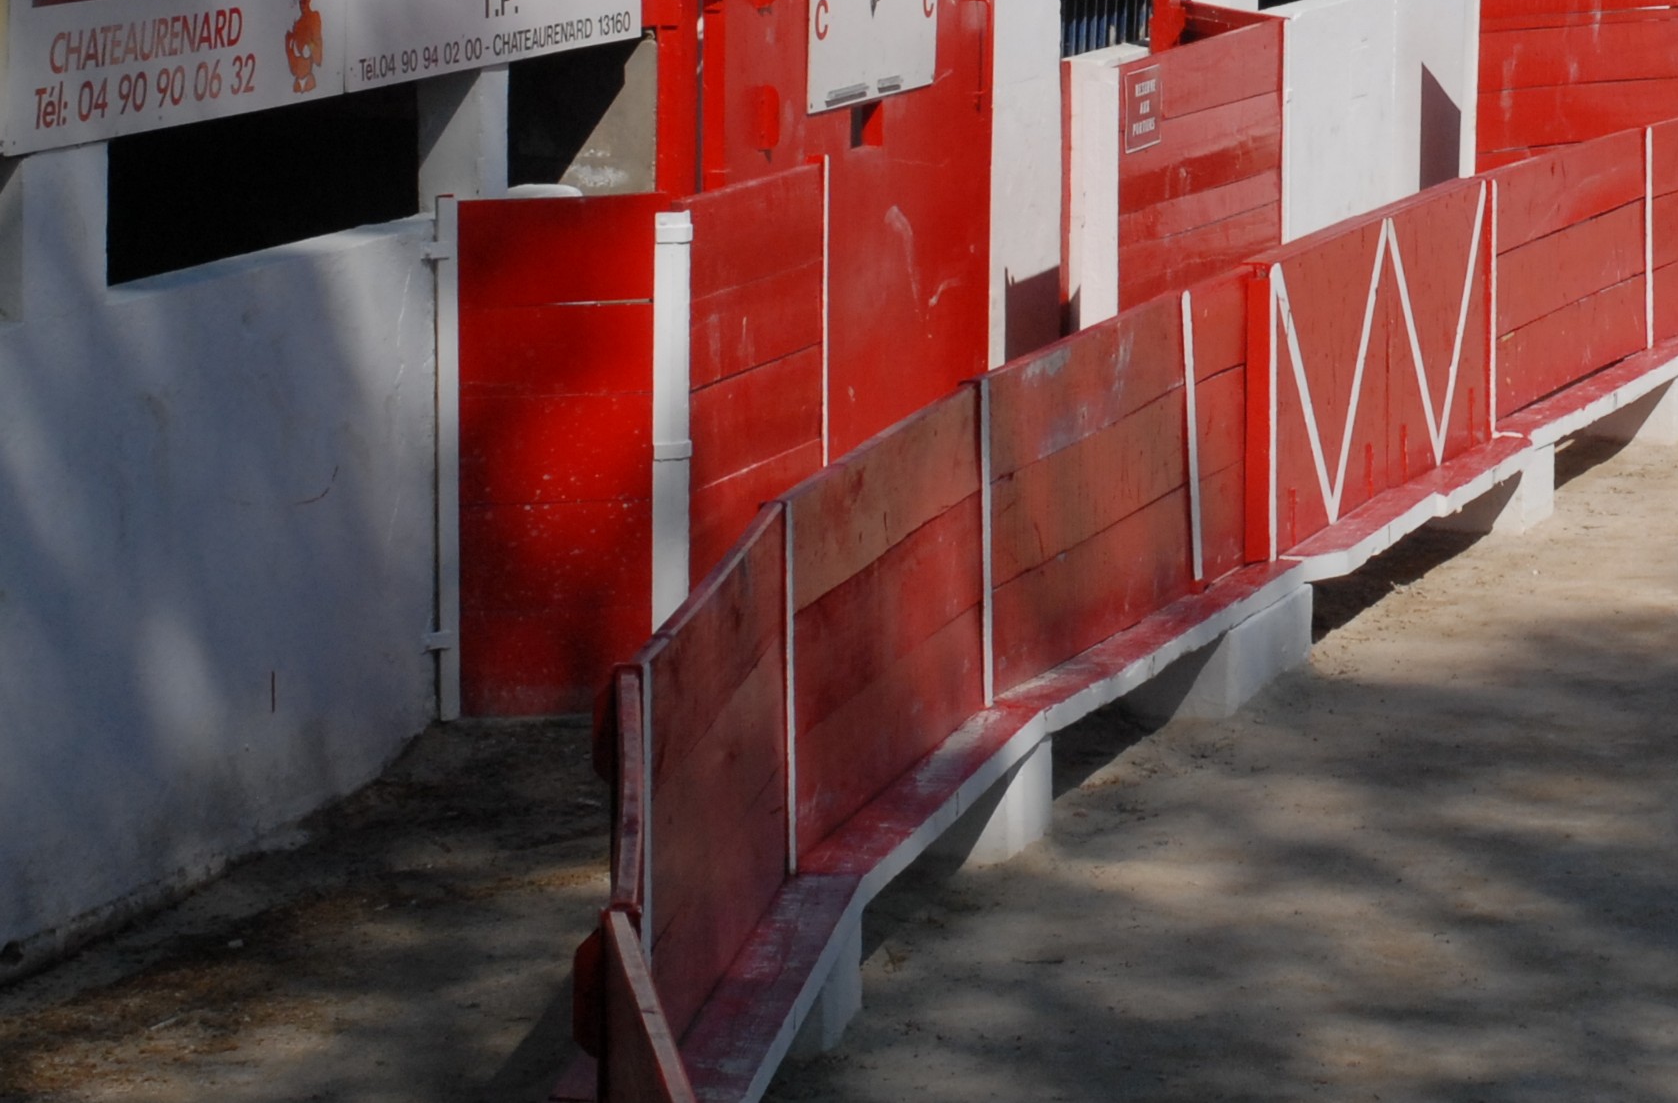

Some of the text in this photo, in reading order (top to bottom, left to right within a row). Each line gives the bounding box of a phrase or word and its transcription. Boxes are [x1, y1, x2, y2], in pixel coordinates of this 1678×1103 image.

[49, 7, 243, 74] CHATEAURENARD
[402, 49, 418, 73] 90
[423, 45, 439, 69] 94
[444, 42, 460, 65] 02
[465, 37, 483, 61] 00
[492, 18, 593, 56] CHATEAURENARD
[598, 11, 631, 37] 13160
[35, 53, 256, 130] Tél: 04 90 90 06 32
